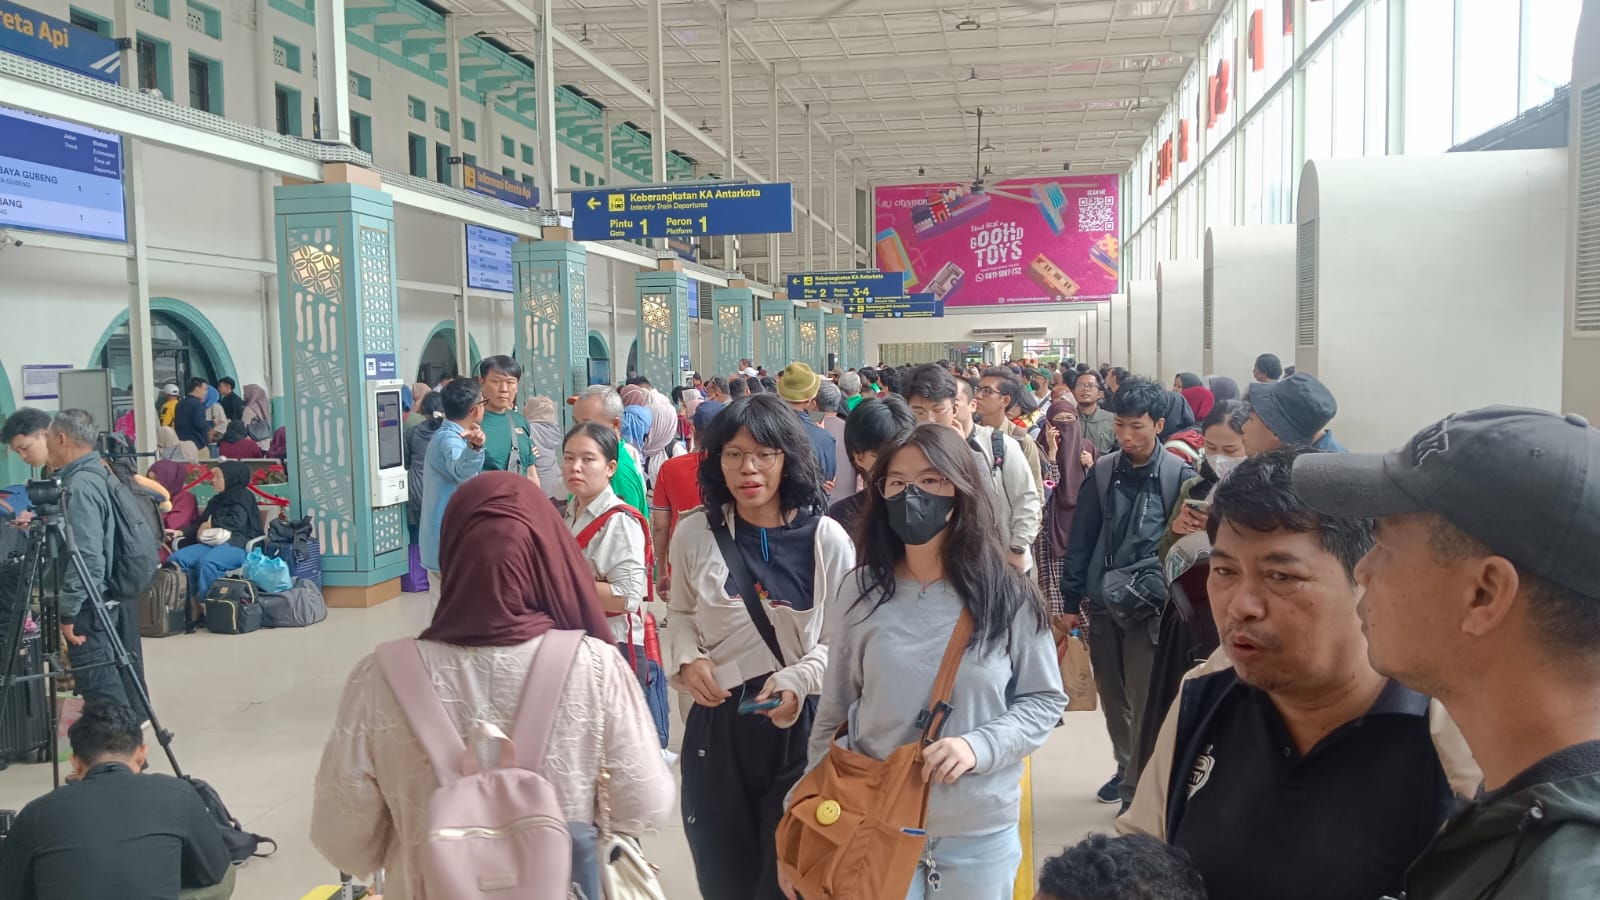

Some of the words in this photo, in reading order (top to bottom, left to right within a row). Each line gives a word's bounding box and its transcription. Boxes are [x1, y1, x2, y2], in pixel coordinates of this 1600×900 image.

[38, 21, 69, 48] Api
[22, 170, 58, 185] GUBENG
[630, 190, 697, 203] Keberangkatan
[699, 190, 714, 199] KA
[715, 188, 761, 199] Antarkota
[894, 197, 928, 208] cityvision
[630, 202, 654, 211] Intercity
[655, 202, 673, 211] Train
[673, 201, 709, 211] Departures
[610, 219, 633, 229] Pintu
[639, 218, 648, 236] 1
[666, 216, 692, 227] Peron
[698, 215, 707, 233] 1
[610, 229, 626, 238] Gate
[666, 227, 693, 236] Platform
[974, 240, 1023, 268] TOYS
[820, 288, 827, 298] 2
